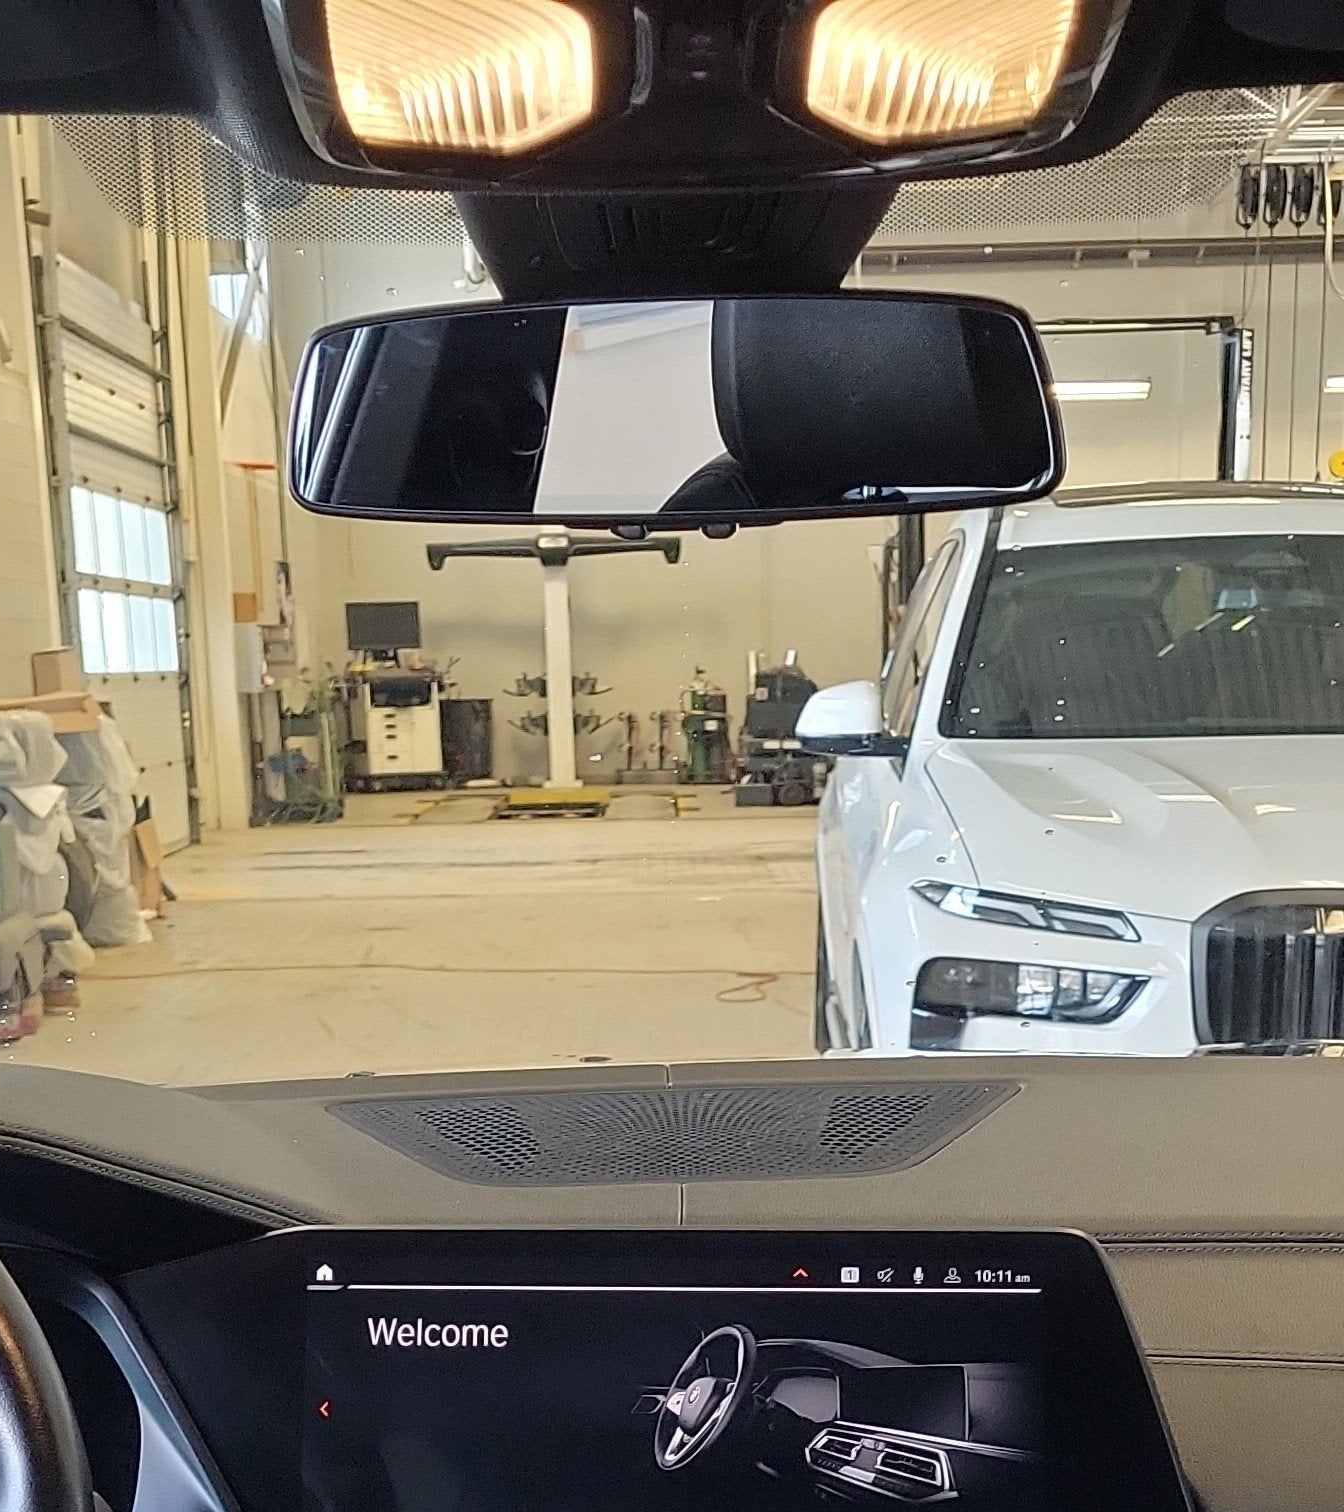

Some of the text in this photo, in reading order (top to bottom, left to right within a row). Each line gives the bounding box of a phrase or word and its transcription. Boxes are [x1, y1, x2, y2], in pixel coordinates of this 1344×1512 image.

[974, 1269, 1031, 1284] 10:11 am
[367, 1317, 509, 1347] Welcome
